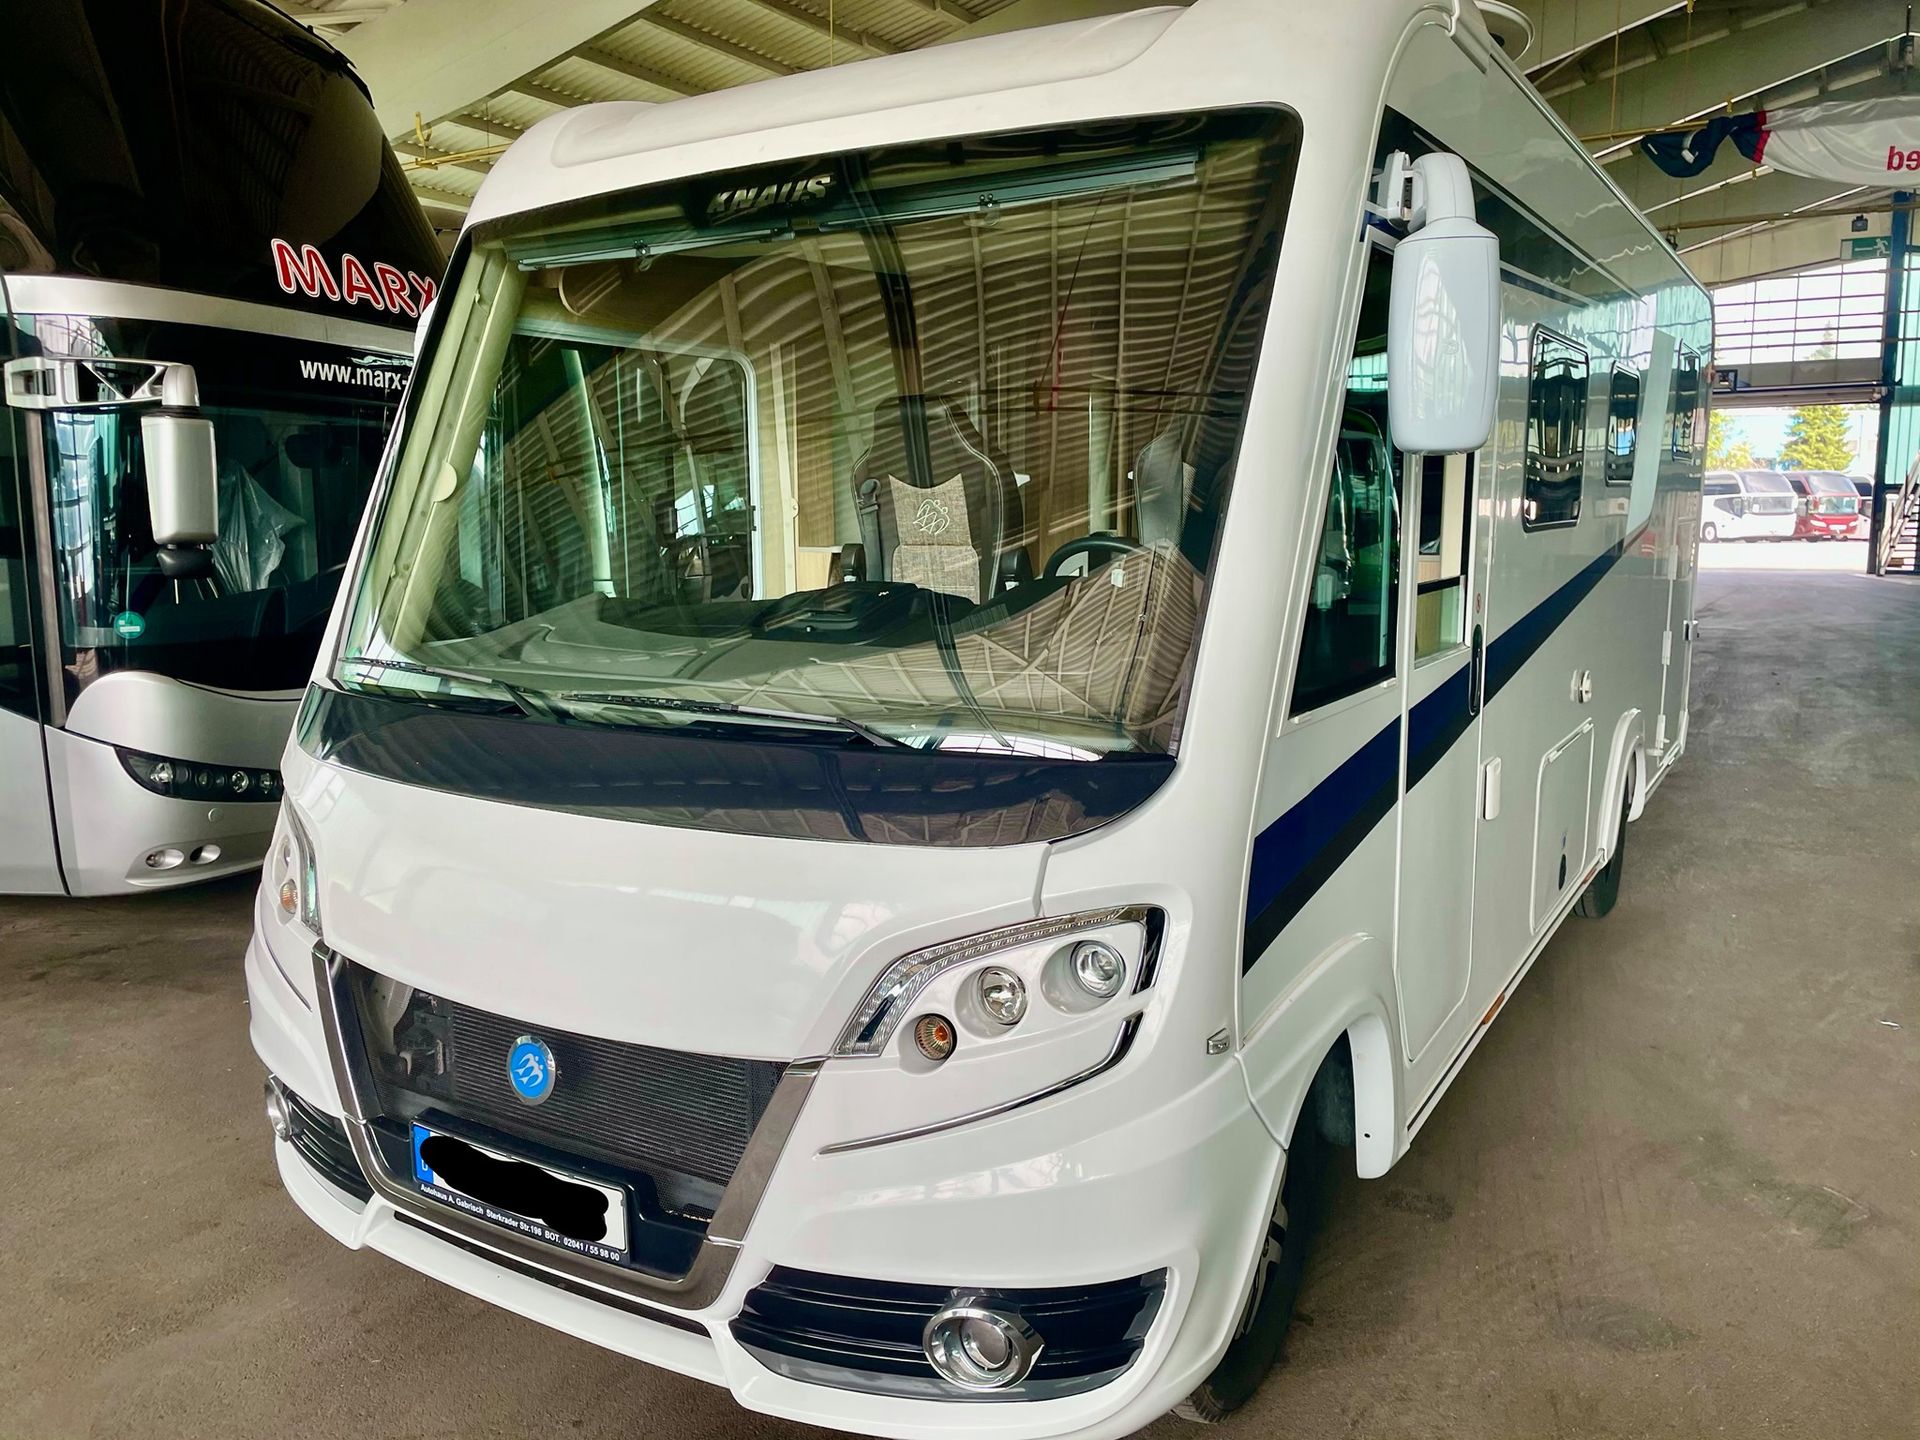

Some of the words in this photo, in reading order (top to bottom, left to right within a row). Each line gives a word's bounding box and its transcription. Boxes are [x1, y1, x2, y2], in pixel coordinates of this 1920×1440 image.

[706, 176, 831, 214] KNAUS
[271, 238, 437, 317] MARX
[300, 359, 411, 390] www.marx-
[420, 1183, 448, 1201] Autohaus
[448, 1194, 455, 1204] A.
[455, 1197, 484, 1215] Gabrisch
[486, 1209, 519, 1228] Sterkrader
[544, 1230, 561, 1243] BOT.
[562, 1236, 584, 1251] 02041
[589, 1245, 599, 1255] 55
[599, 1248, 609, 1258] 98
[610, 1252, 620, 1262] 00
